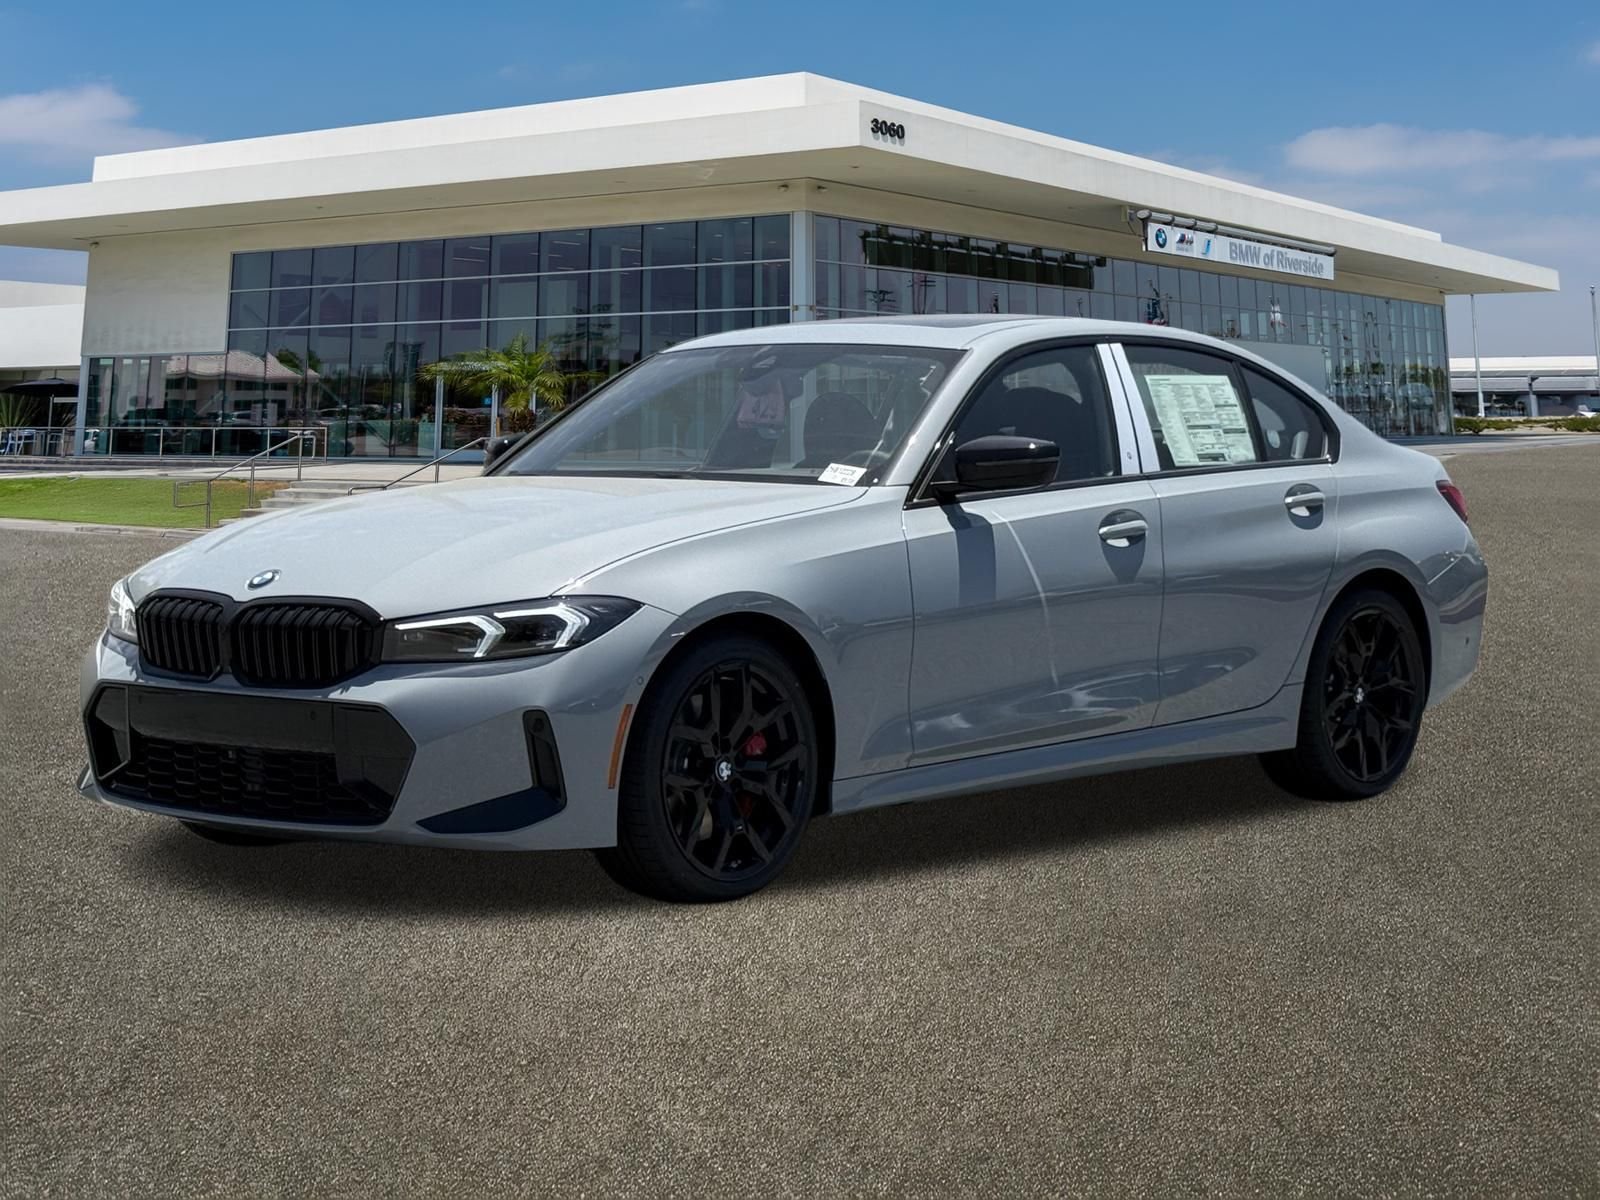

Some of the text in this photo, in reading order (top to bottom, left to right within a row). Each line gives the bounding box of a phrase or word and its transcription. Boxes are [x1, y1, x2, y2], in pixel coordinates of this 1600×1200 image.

[871, 118, 905, 139] 3060
[1229, 241, 1324, 275] BMW of Riverside
